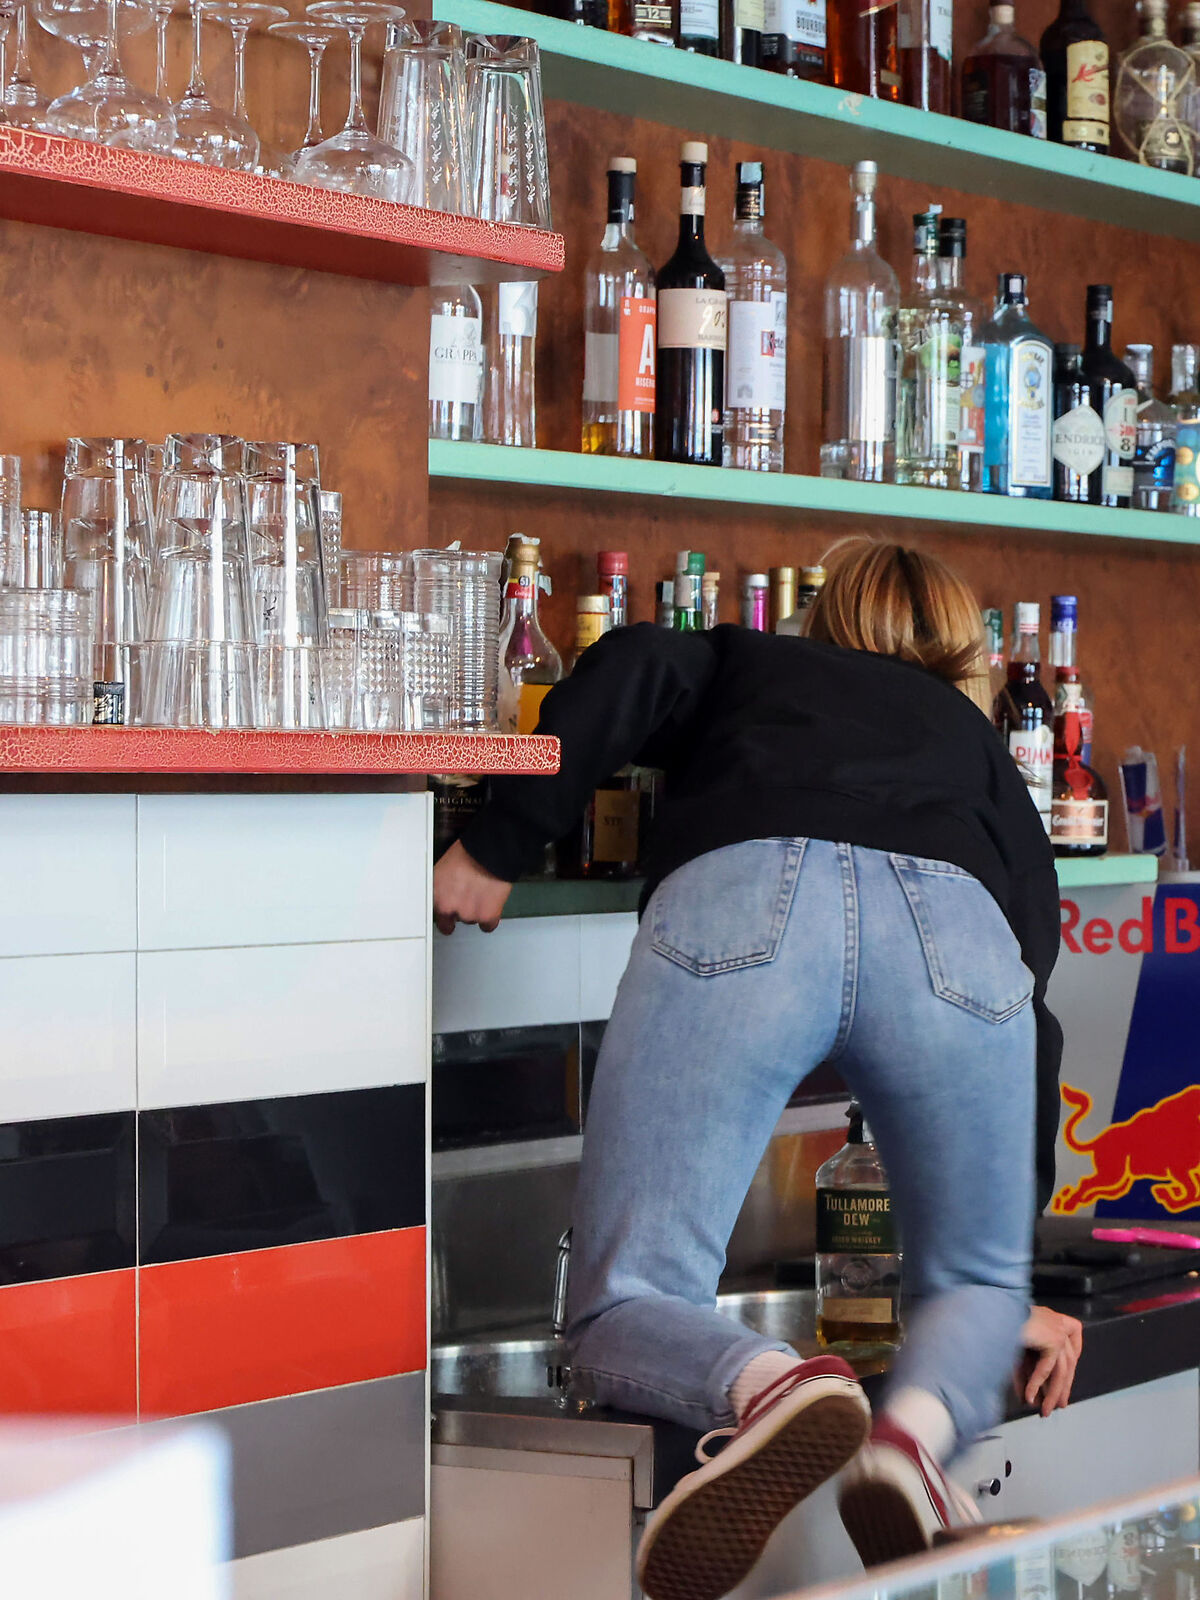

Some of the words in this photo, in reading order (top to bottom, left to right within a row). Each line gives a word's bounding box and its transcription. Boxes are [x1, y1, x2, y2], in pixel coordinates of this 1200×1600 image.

[647, 8, 659, 19] 12
[519, 576, 530, 587] 51
[1060, 896, 1154, 955] Red
[825, 1194, 891, 1212] TULLAMORE
[843, 1213, 870, 1226] DEW
